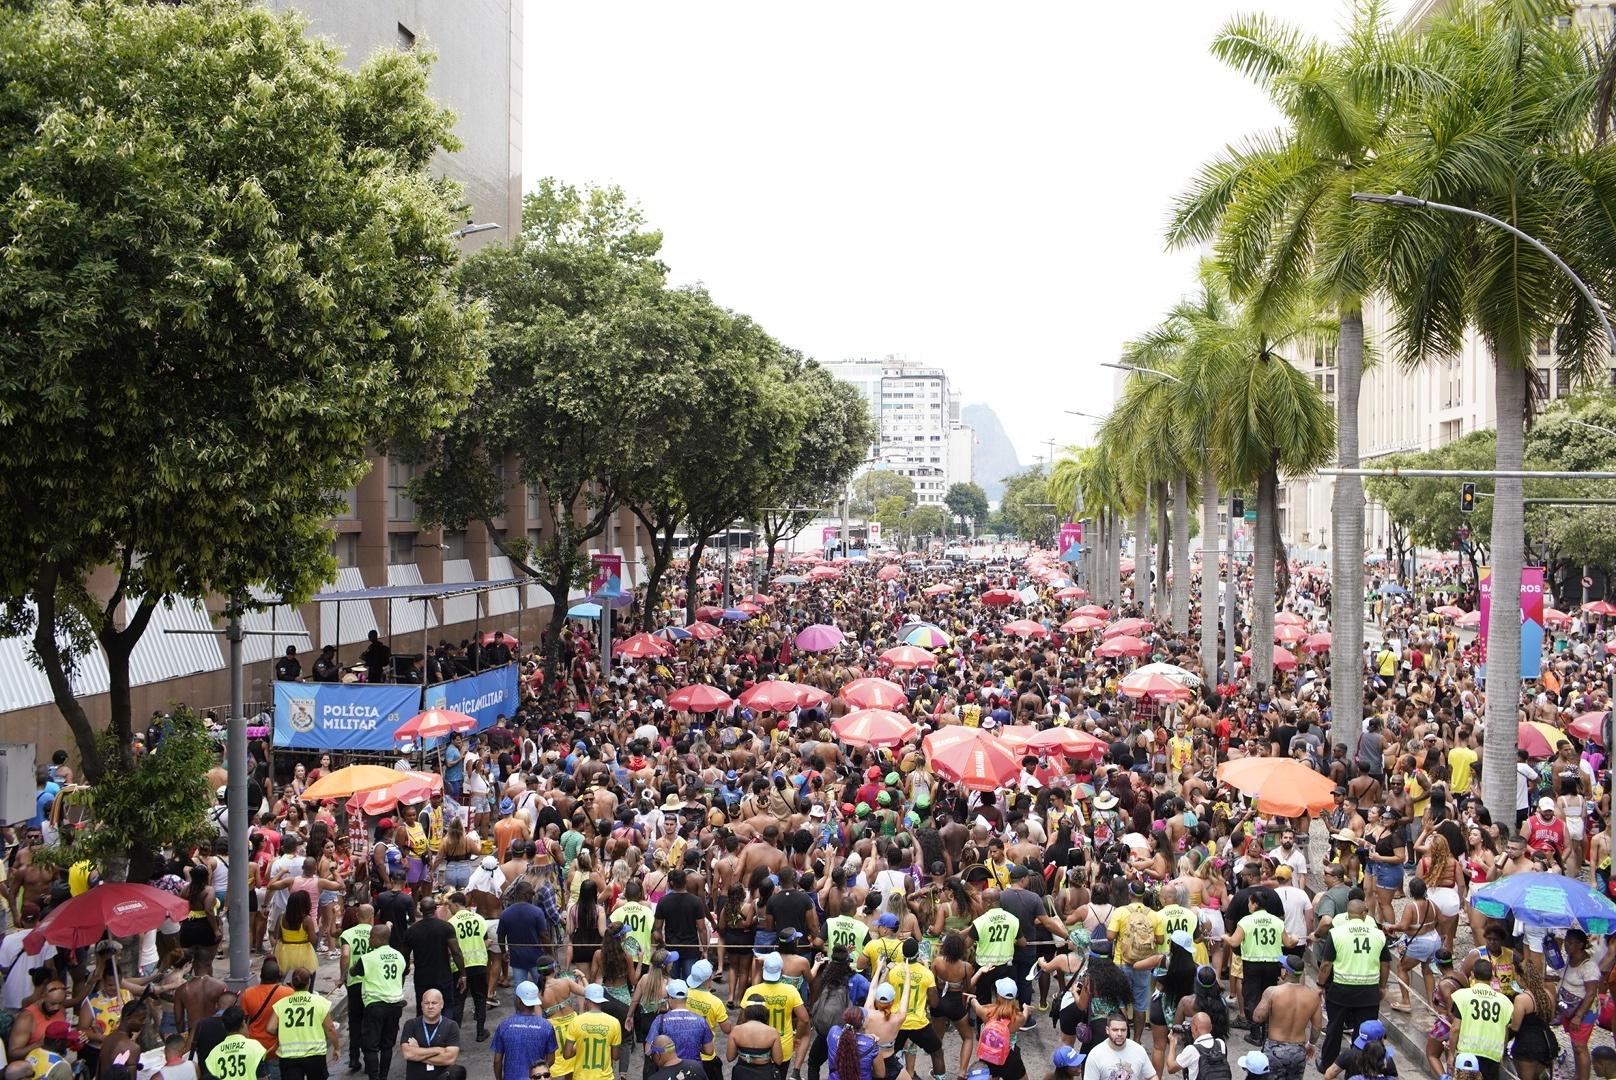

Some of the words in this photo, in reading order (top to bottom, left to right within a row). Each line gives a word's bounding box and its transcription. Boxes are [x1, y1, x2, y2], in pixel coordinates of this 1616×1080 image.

[479, 690, 503, 709] MILITAR
[323, 703, 379, 717] POLÍCIA
[323, 719, 377, 730] MILITAR
[457, 919, 480, 939] 382
[988, 924, 1010, 942] 227
[1166, 918, 1188, 935] 446
[1253, 927, 1276, 945] 133
[1353, 937, 1371, 954] 14
[383, 964, 397, 980] 39
[1472, 989, 1497, 997] UNIPAZ
[284, 1006, 315, 1028] 321
[1470, 999, 1501, 1023] 389
[220, 1041, 246, 1052] UNIPAZ
[583, 1037, 607, 1069] 10
[217, 1054, 247, 1080] 335
